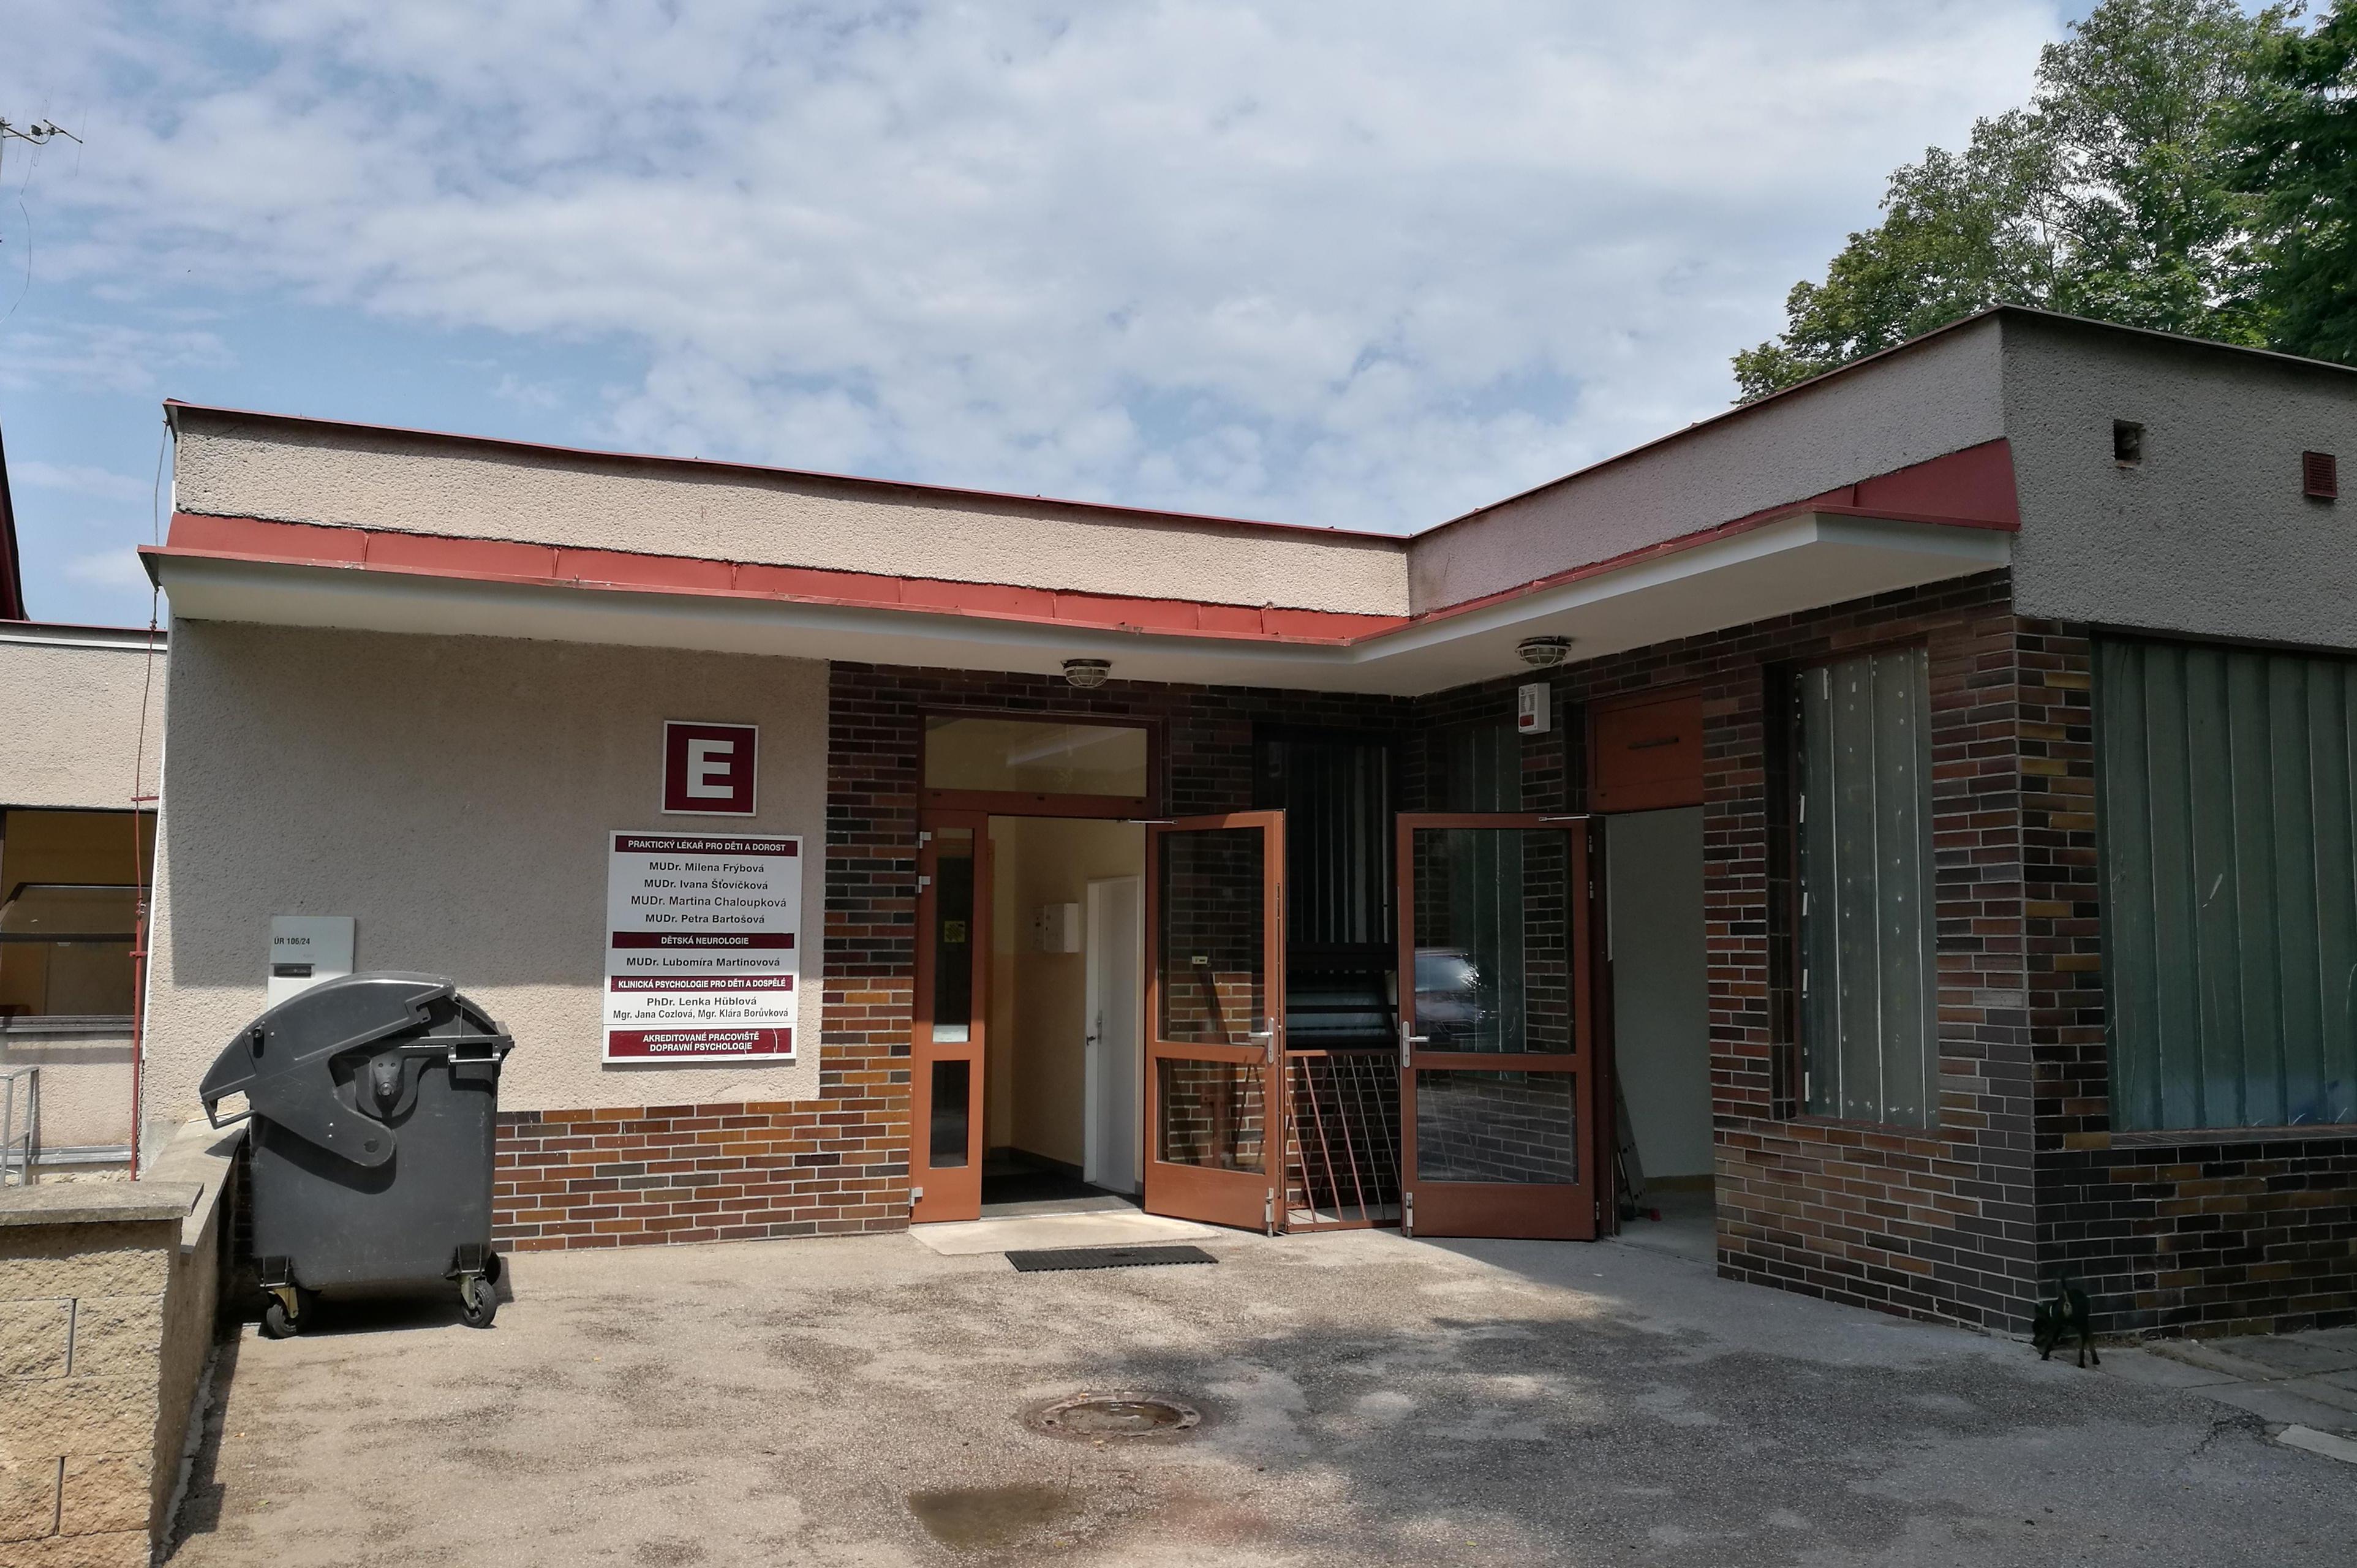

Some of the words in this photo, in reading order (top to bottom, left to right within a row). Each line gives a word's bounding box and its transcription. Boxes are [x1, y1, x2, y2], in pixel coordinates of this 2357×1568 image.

[687, 739, 734, 799] E
[628, 839, 675, 849] PRAKTICKÝ
[676, 840, 704, 850] LÉKAŘ
[725, 841, 743, 850] DĚTI
[649, 862, 681, 870] MUDr.
[723, 864, 764, 874] Frýbová
[680, 880, 707, 889] Ivana
[631, 895, 665, 905] MUDr.
[669, 897, 711, 906] Martina
[715, 897, 786, 909] Chaloupková
[712, 915, 764, 924] Bartošová
[274, 936, 284, 944] ÚR
[661, 935, 694, 944] DĚTSKÁ
[663, 957, 712, 967] Lubomíra
[717, 957, 780, 967] Martinovová
[619, 979, 654, 988] KLINICKÁ
[728, 979, 744, 987] DĚTI
[753, 978, 785, 987] DOSPĚLÉ
[647, 998, 675, 1006] PhDr.
[714, 997, 756, 1005] Hüblová
[613, 1011, 632, 1020] Mgr.
[698, 1010, 717, 1019] Mgr.
[719, 1009, 741, 1017] Klára
[744, 1008, 788, 1017] Borůvková
[643, 1032, 707, 1041] AKREDITOVANÉ
[709, 1032, 760, 1041] PRACOVIŠTĚ
[650, 1041, 692, 1052] DOPRAVNÍ
[694, 1042, 752, 1051] PSYCHOLOGIE
